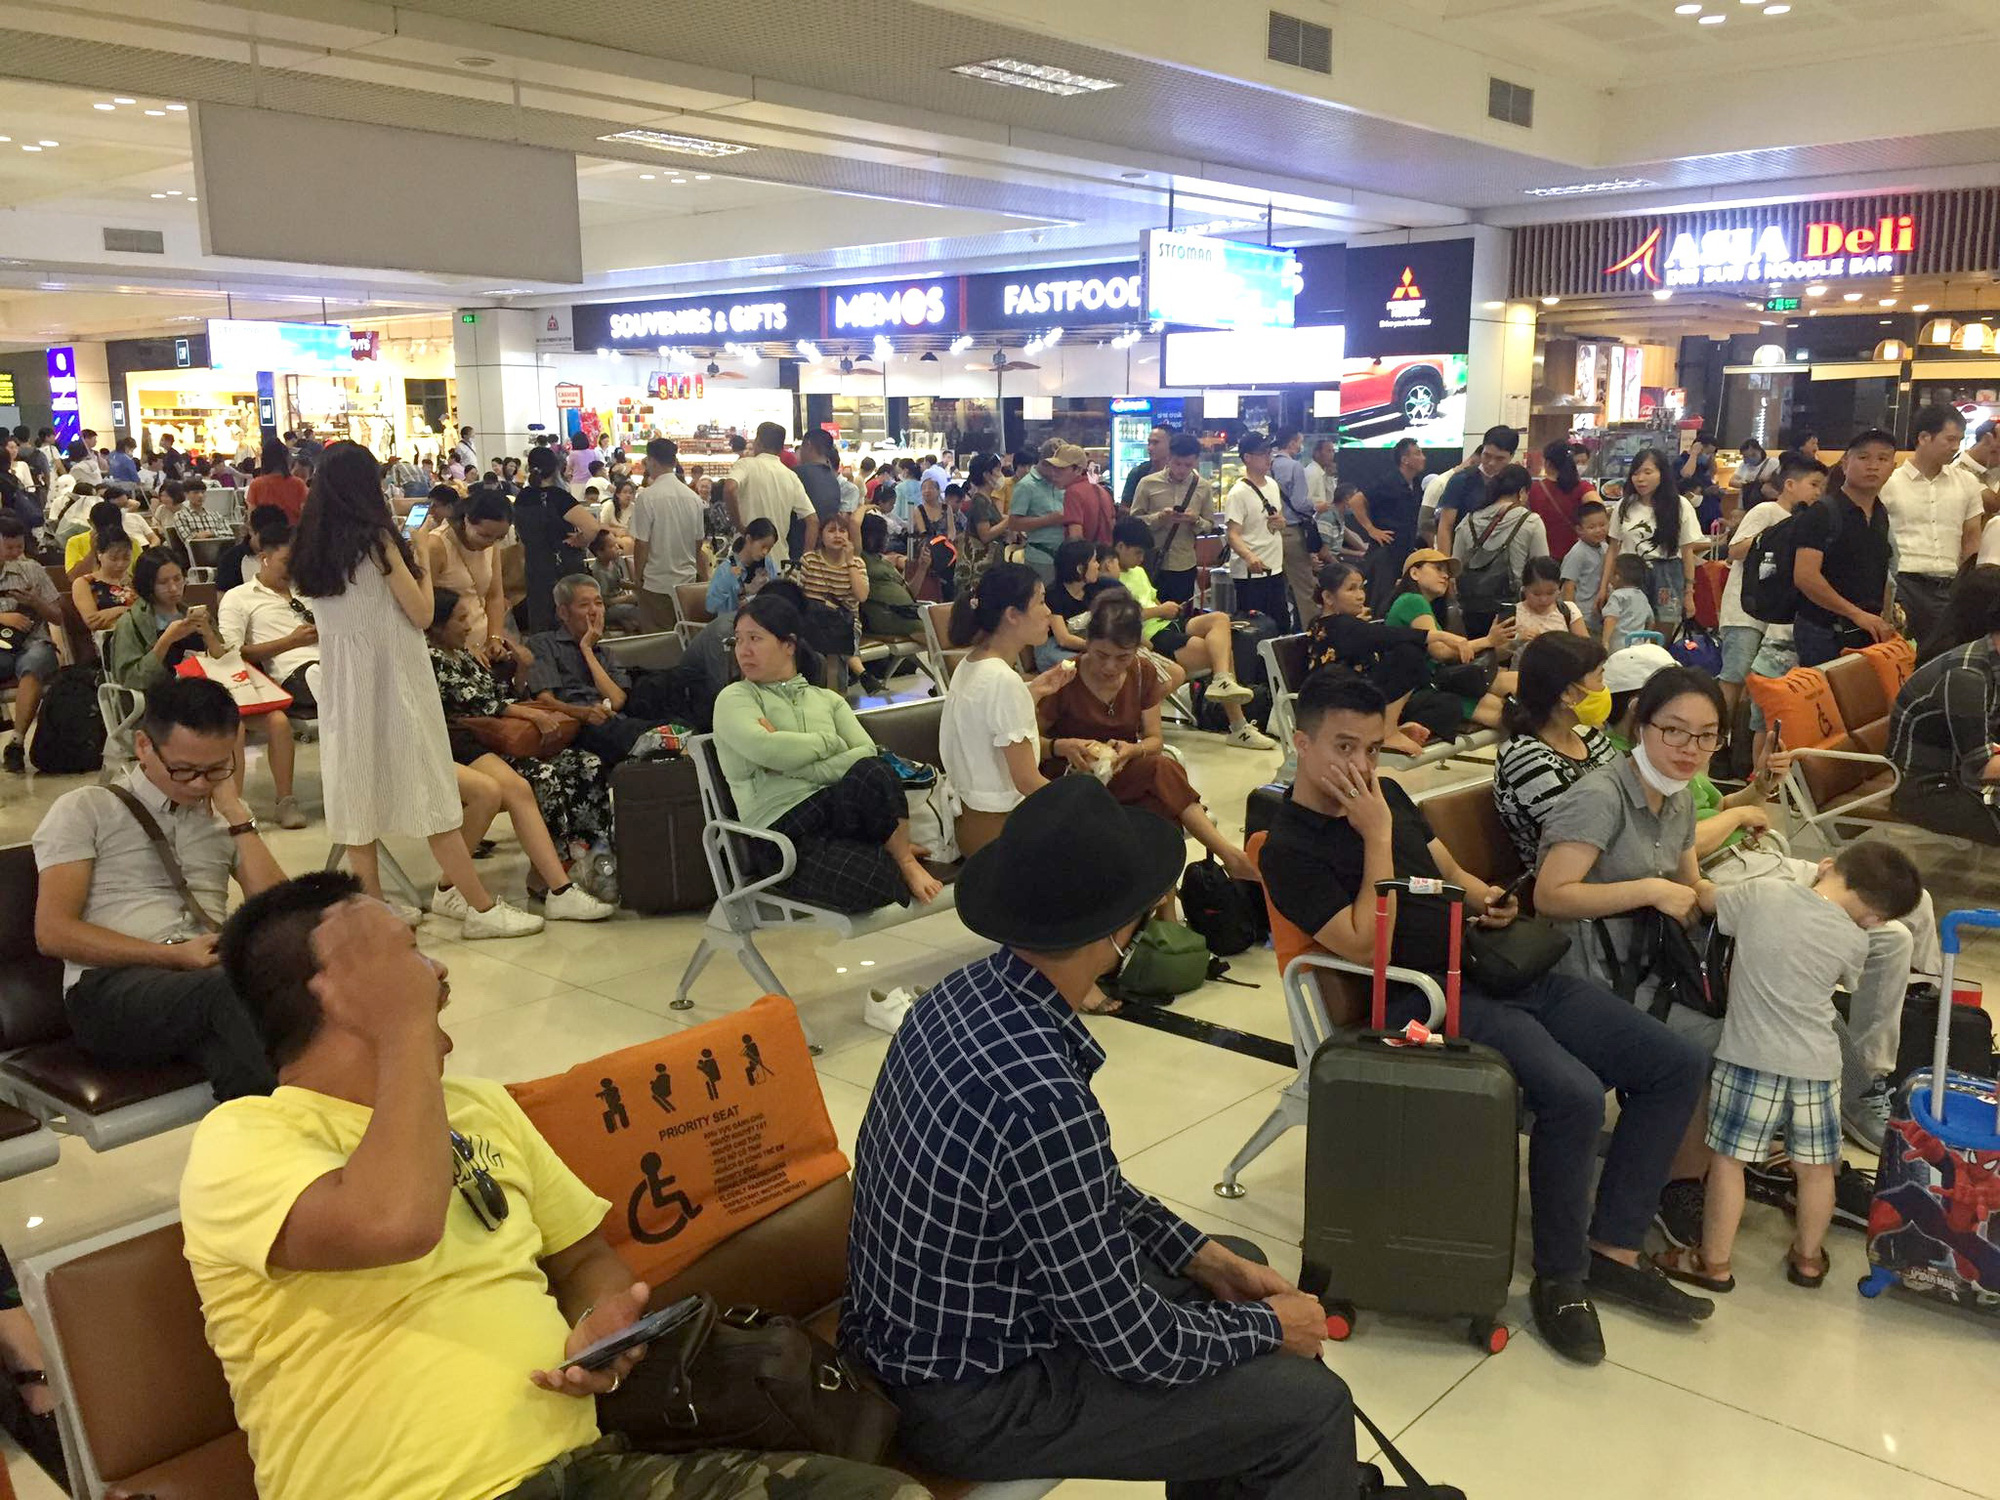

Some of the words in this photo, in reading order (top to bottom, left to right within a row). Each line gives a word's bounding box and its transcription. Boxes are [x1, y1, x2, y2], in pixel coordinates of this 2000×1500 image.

[1804, 214, 1915, 259] Deli
[1747, 263, 1761, 281] &
[1765, 258, 1845, 280] NOODLE
[1849, 255, 1893, 274] BAR
[609, 307, 713, 339] SOUVENIRS
[713, 310, 728, 333] &
[729, 302, 788, 333] GIFTS
[835, 285, 946, 329] MEMOS
[659, 383, 704, 400] SALE
[659, 1115, 711, 1141] PRIORITY
[712, 1105, 740, 1123] SEAT
